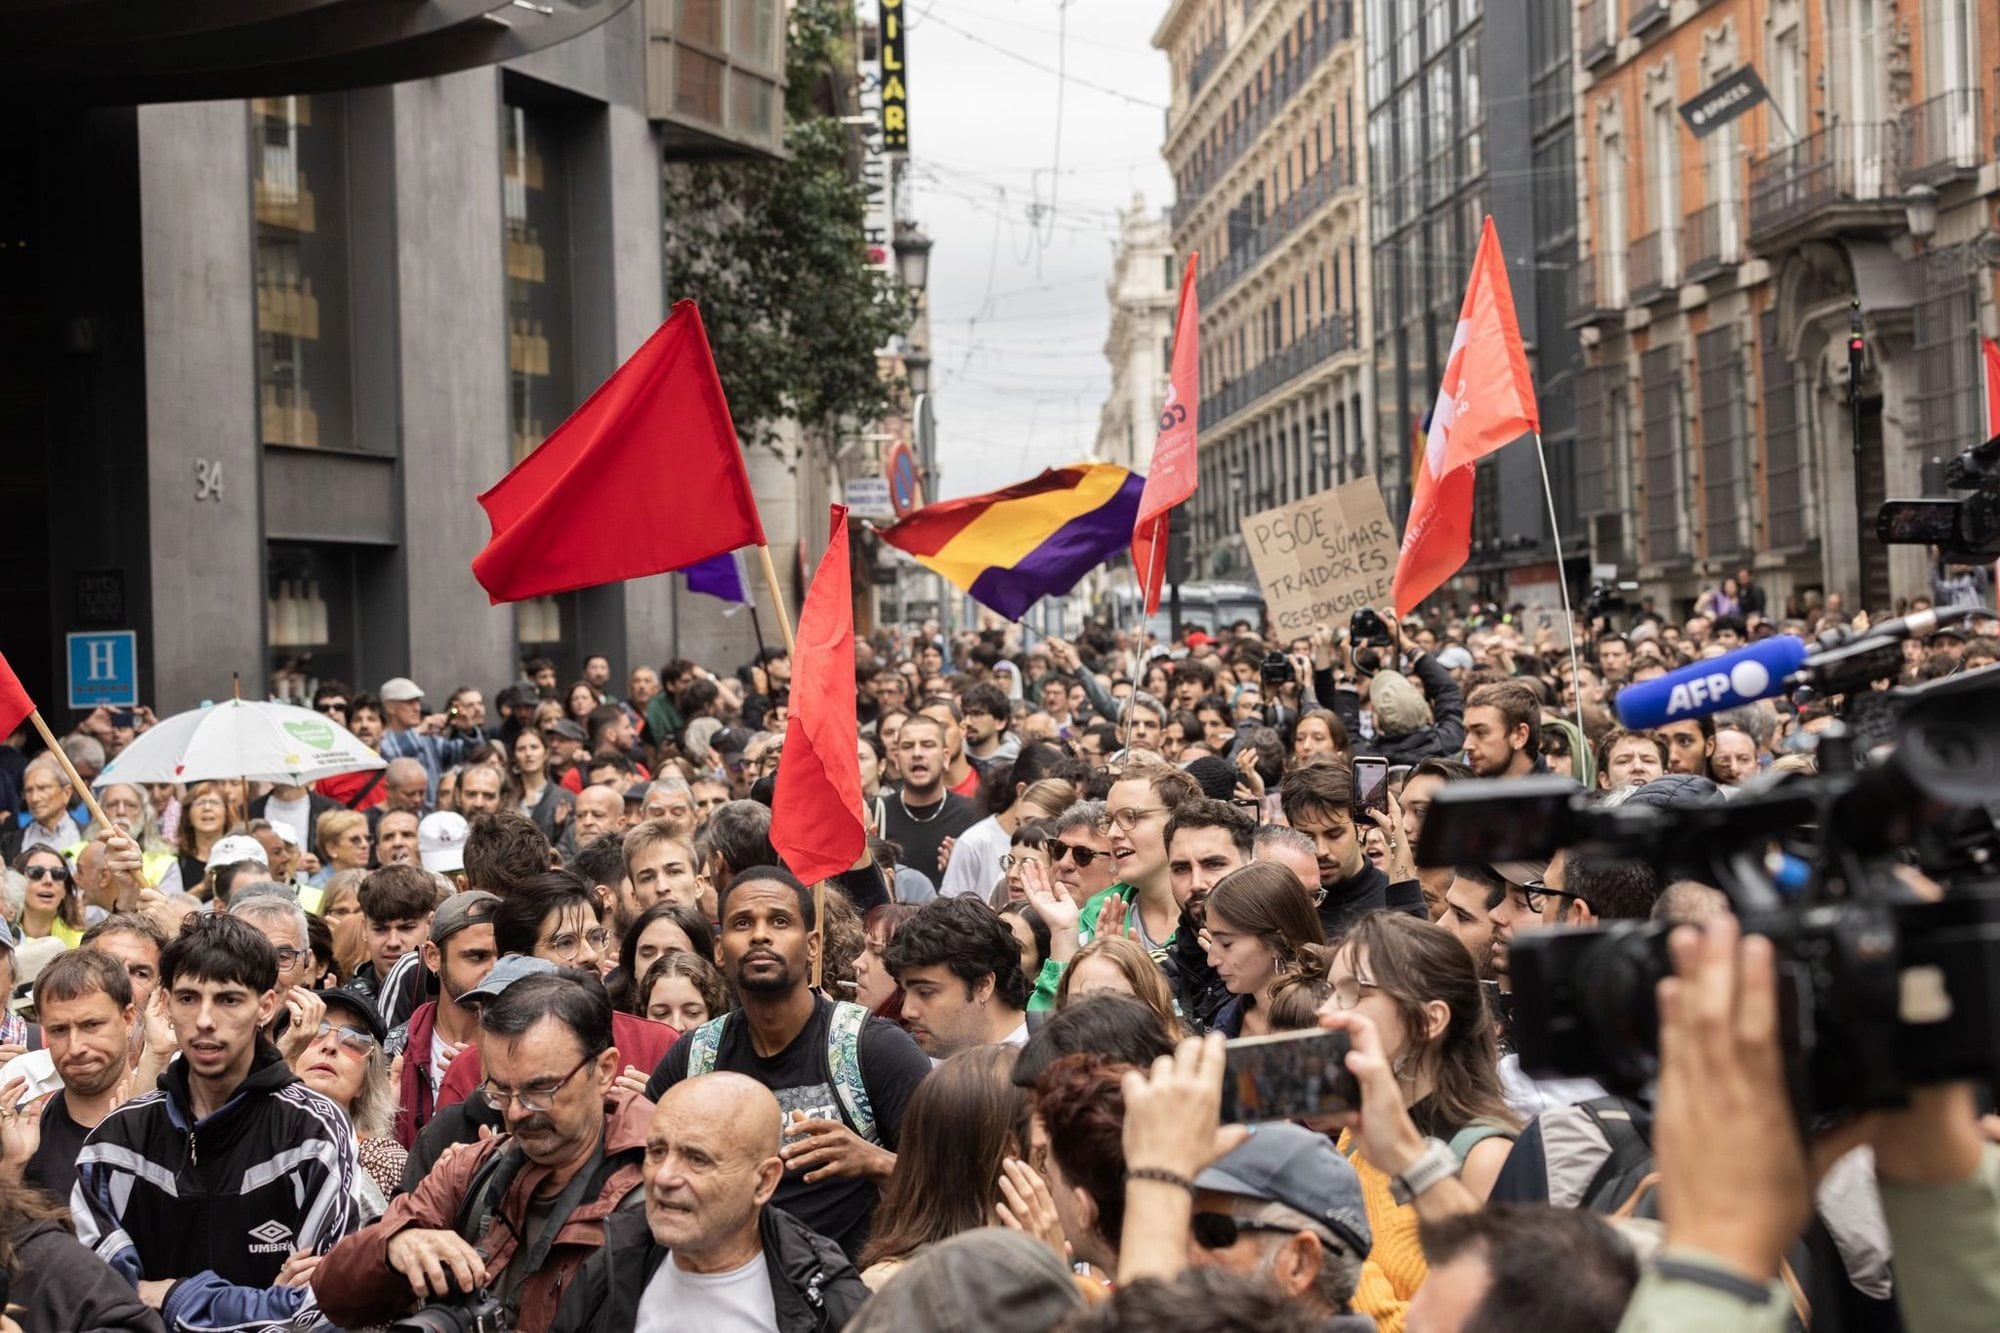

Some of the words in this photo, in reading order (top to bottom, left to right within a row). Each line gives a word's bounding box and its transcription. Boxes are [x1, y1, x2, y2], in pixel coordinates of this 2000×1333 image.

[195, 458, 223, 501] 34
[1254, 508, 1325, 555] PSOE
[1321, 520, 1390, 559] SUMAR
[1268, 549, 1388, 600] TRAIDORES
[86, 640, 118, 680] H
[1665, 672, 1731, 716] AFP
